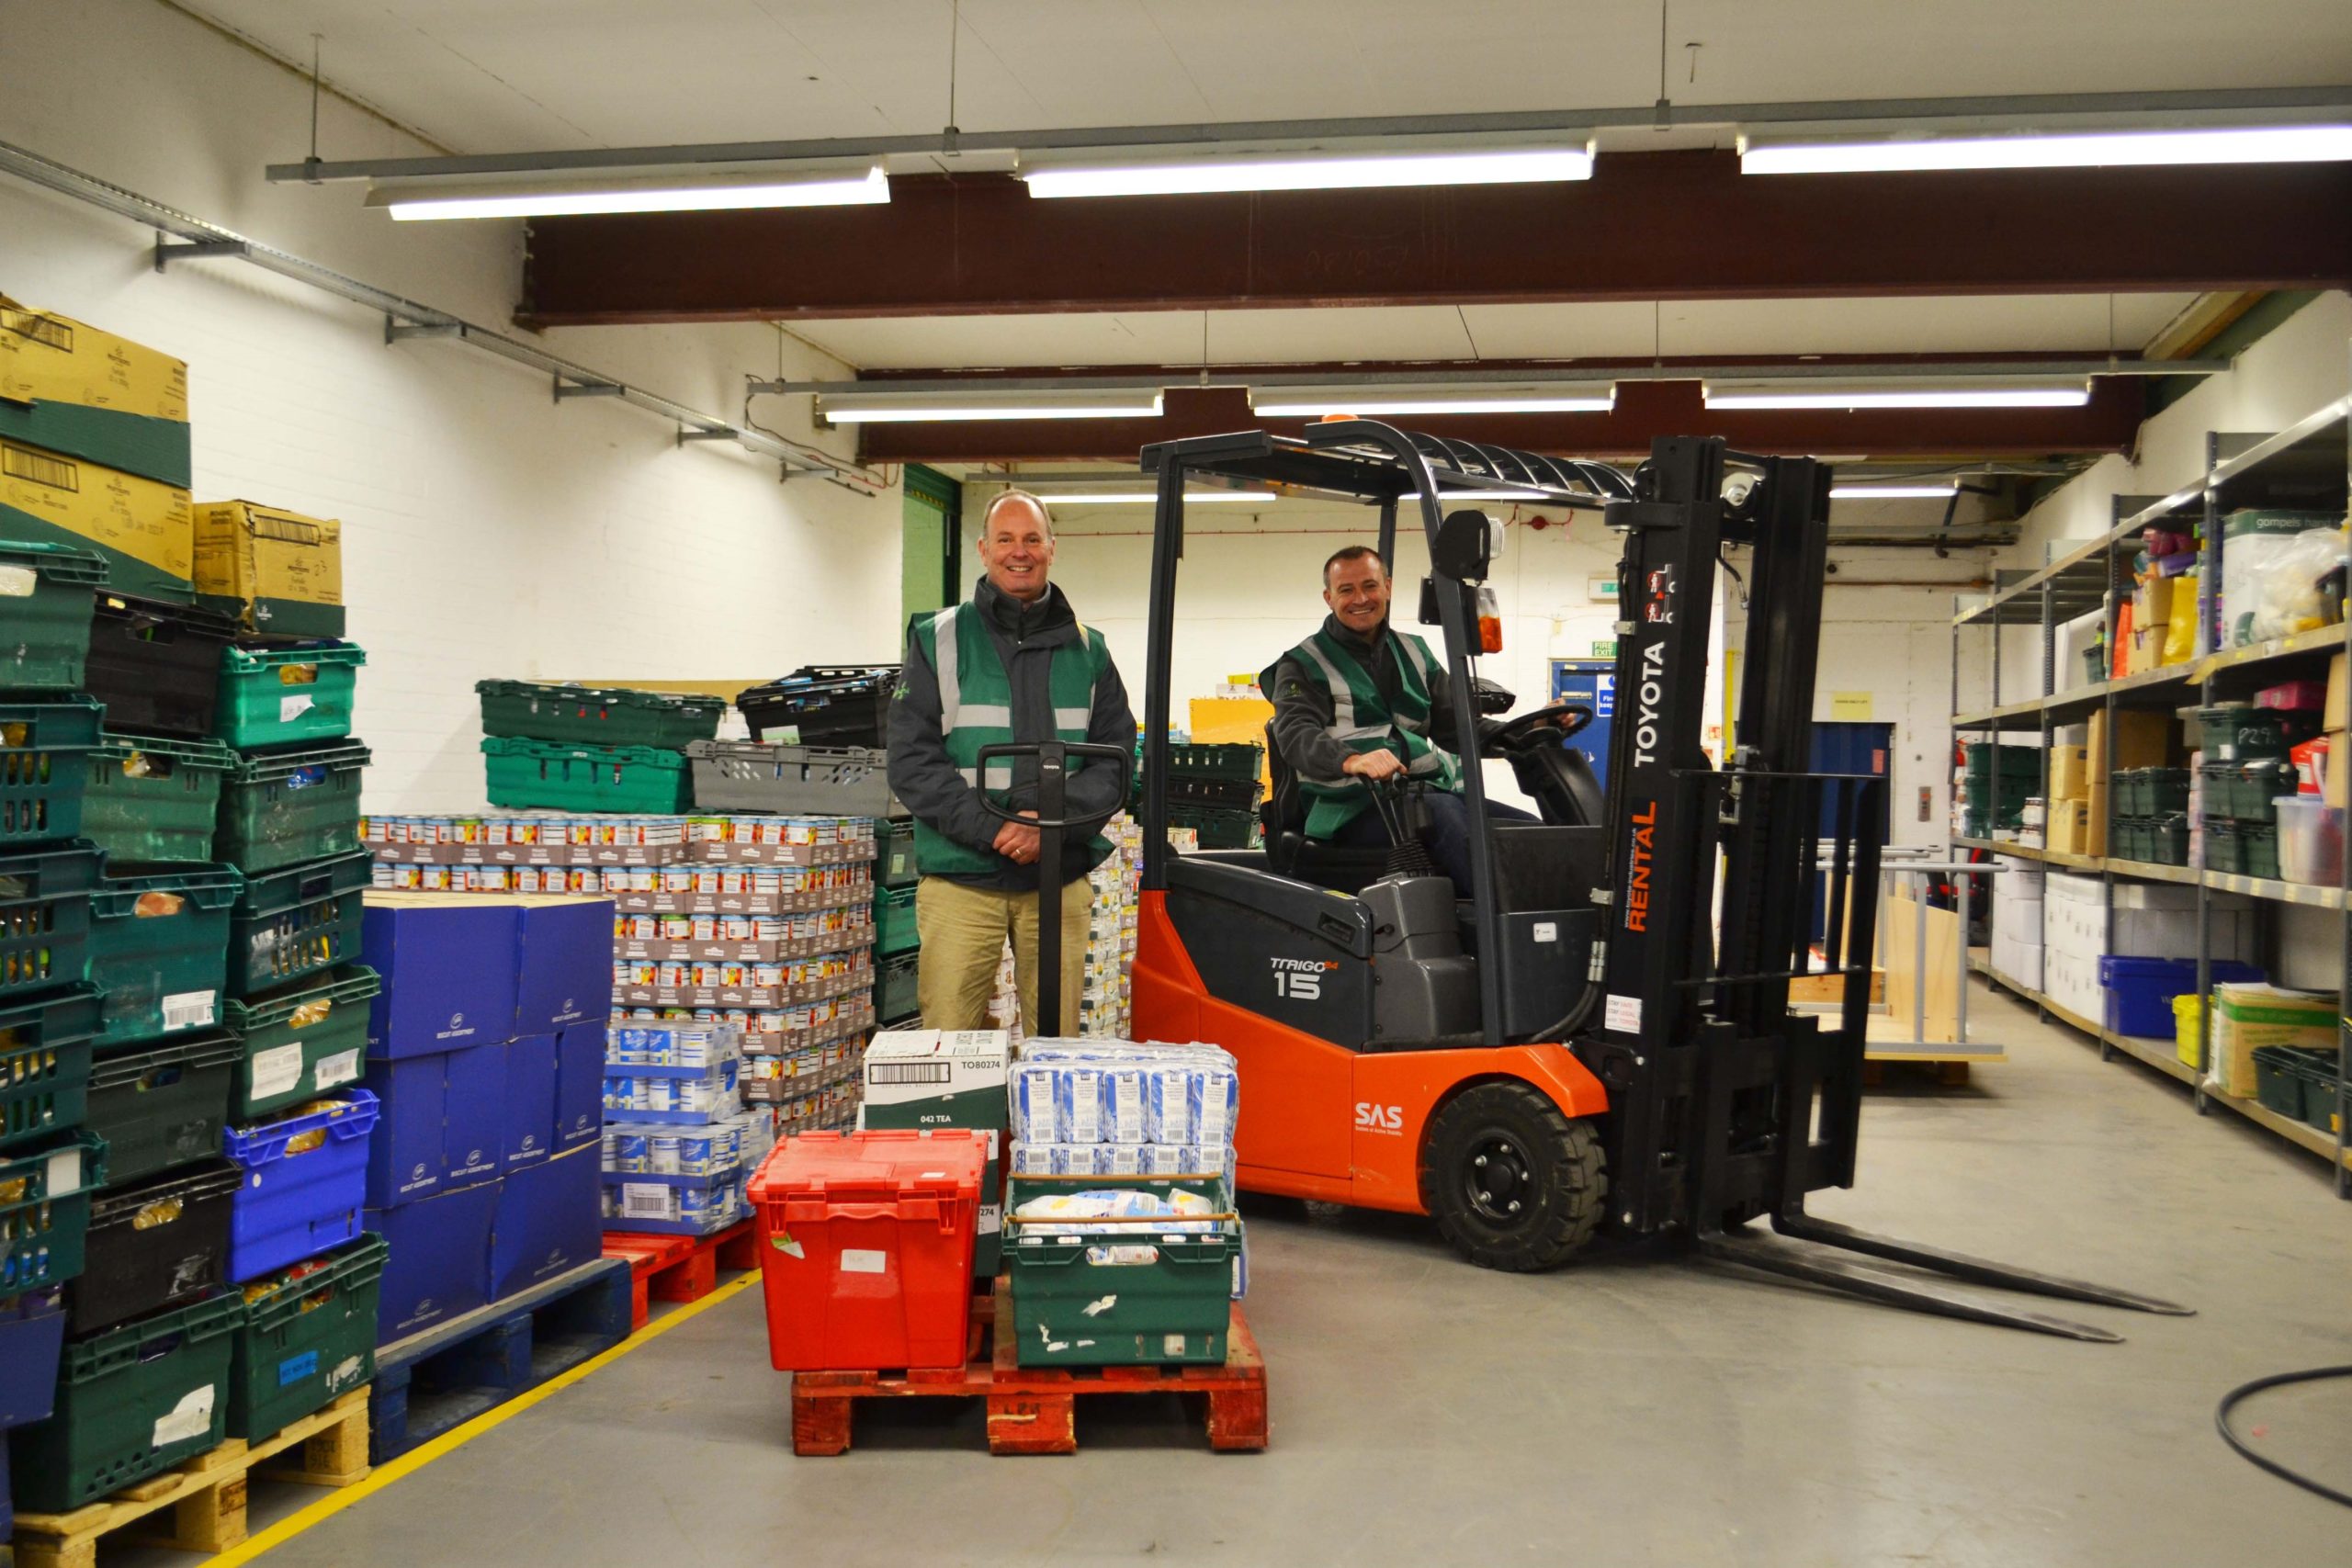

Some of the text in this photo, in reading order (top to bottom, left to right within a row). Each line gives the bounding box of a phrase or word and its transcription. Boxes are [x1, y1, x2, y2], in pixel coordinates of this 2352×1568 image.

[2256, 518, 2301, 528] gompels
[1634, 641, 1665, 768] TOYOTA
[1628, 801, 1657, 932] RENTAL
[1274, 971, 1321, 1000] 15
[961, 1061, 1001, 1069] TO80274
[1355, 1102, 1402, 1129] SAS
